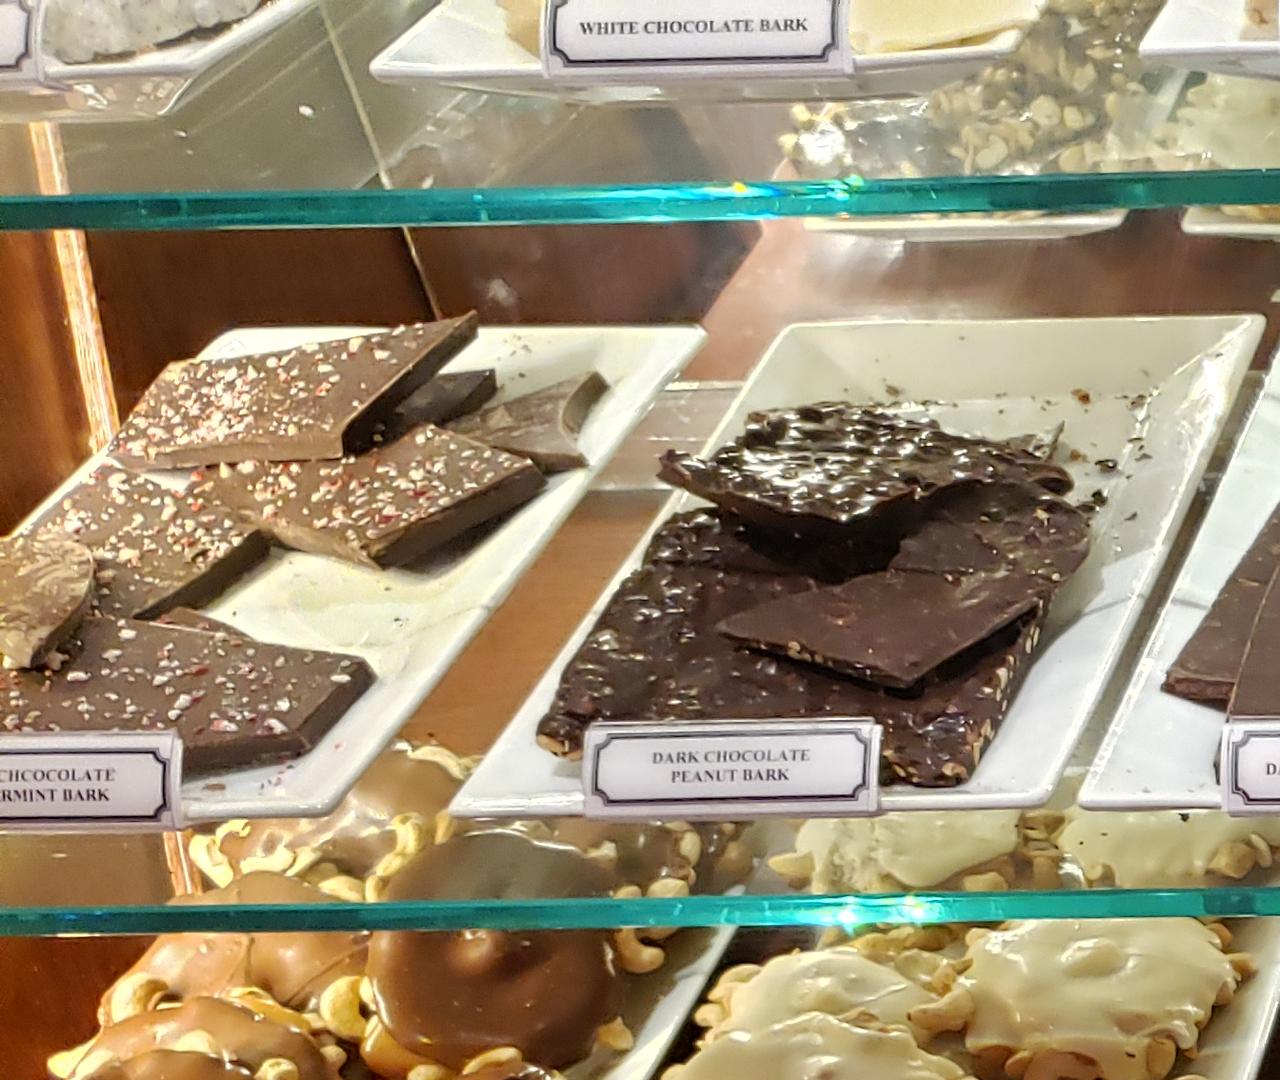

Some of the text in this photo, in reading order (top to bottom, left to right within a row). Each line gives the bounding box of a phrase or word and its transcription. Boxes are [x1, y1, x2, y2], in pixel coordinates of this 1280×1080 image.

[580, 18, 808, 35] WHITE CHOCOLATE BARK
[653, 749, 809, 764] DARK CHOCOLATE
[671, 768, 790, 783] PEANUT BARK
[0, 789, 109, 802] RMINT BARK
